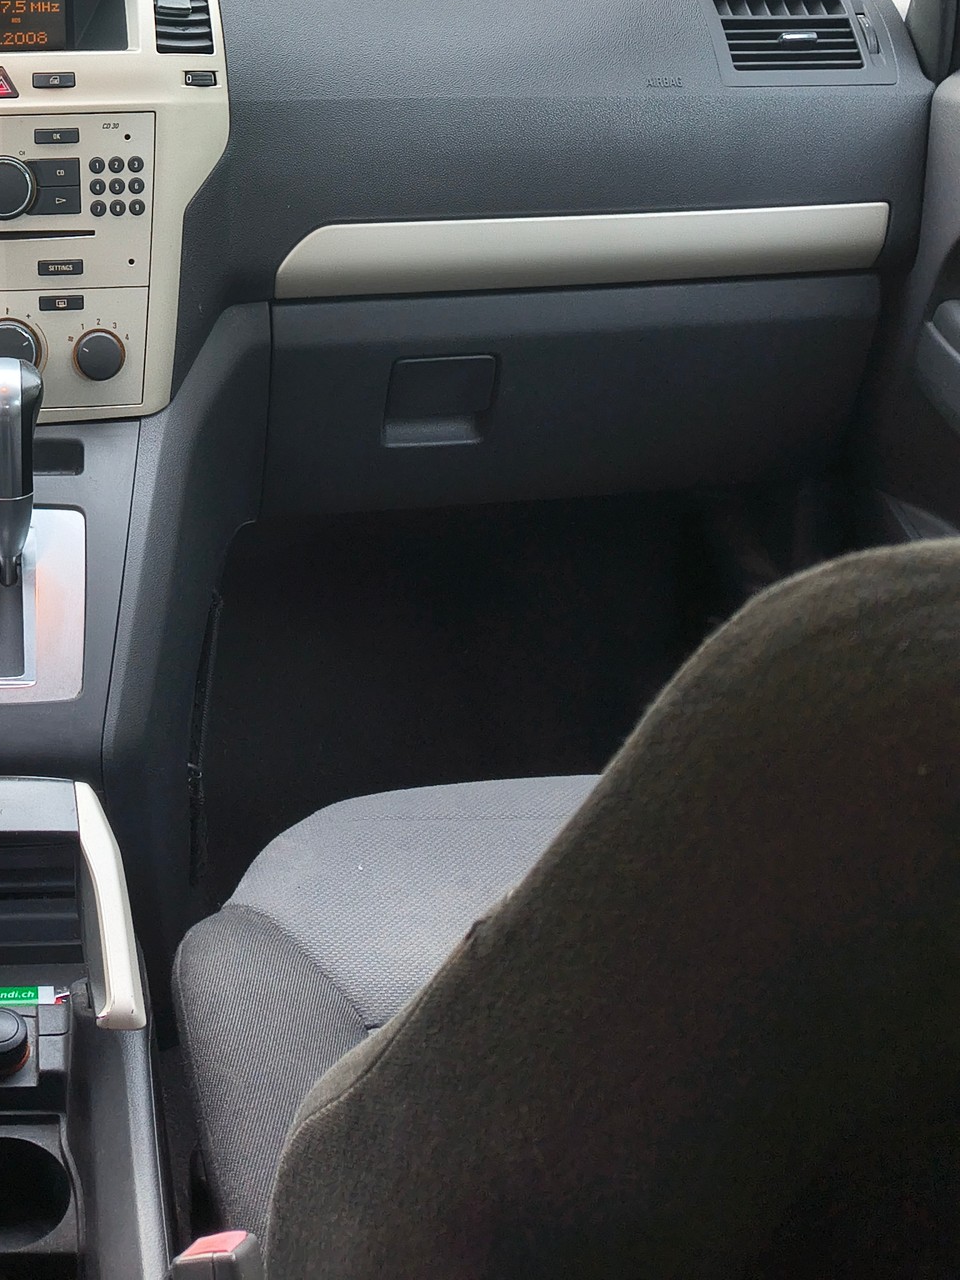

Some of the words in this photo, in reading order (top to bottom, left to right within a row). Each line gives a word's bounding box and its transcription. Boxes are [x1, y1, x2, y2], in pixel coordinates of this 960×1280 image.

[30, 1, 60, 12] MHz
[646, 76, 683, 88] AIRBAG
[48, 264, 73, 272] SETTINGS
